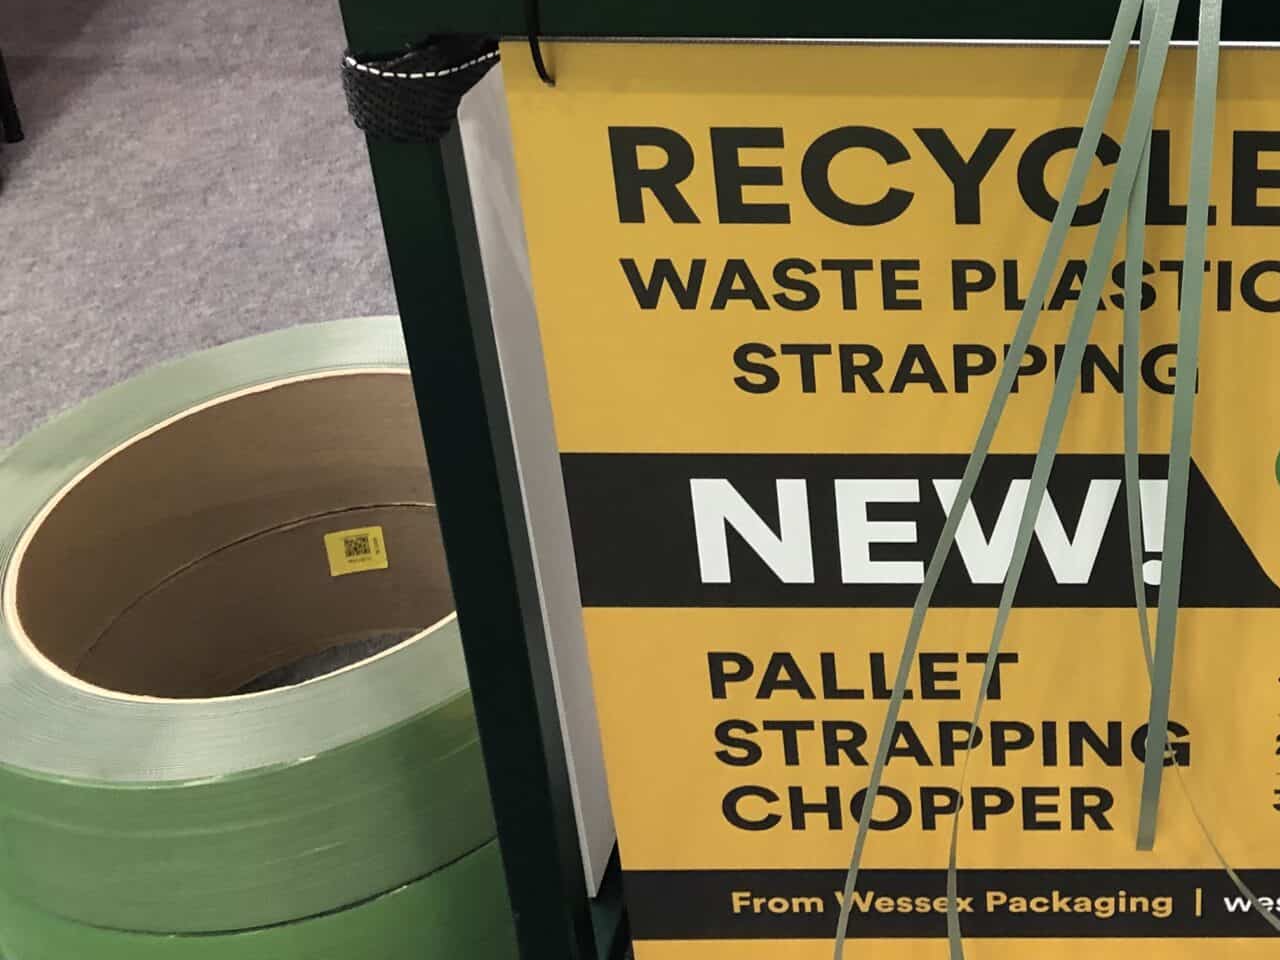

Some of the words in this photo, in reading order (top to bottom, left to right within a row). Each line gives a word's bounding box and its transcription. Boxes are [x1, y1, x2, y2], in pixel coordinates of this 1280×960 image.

[620, 258, 922, 311] WASTE
[689, 478, 1169, 585] NEW!
[707, 651, 1019, 700] PALLET
[714, 719, 1191, 768] STRAPPING
[721, 785, 1114, 831] CHOPPER
[731, 891, 824, 914] From
[834, 891, 974, 913] Wessex
[986, 890, 1173, 918] Packaging
